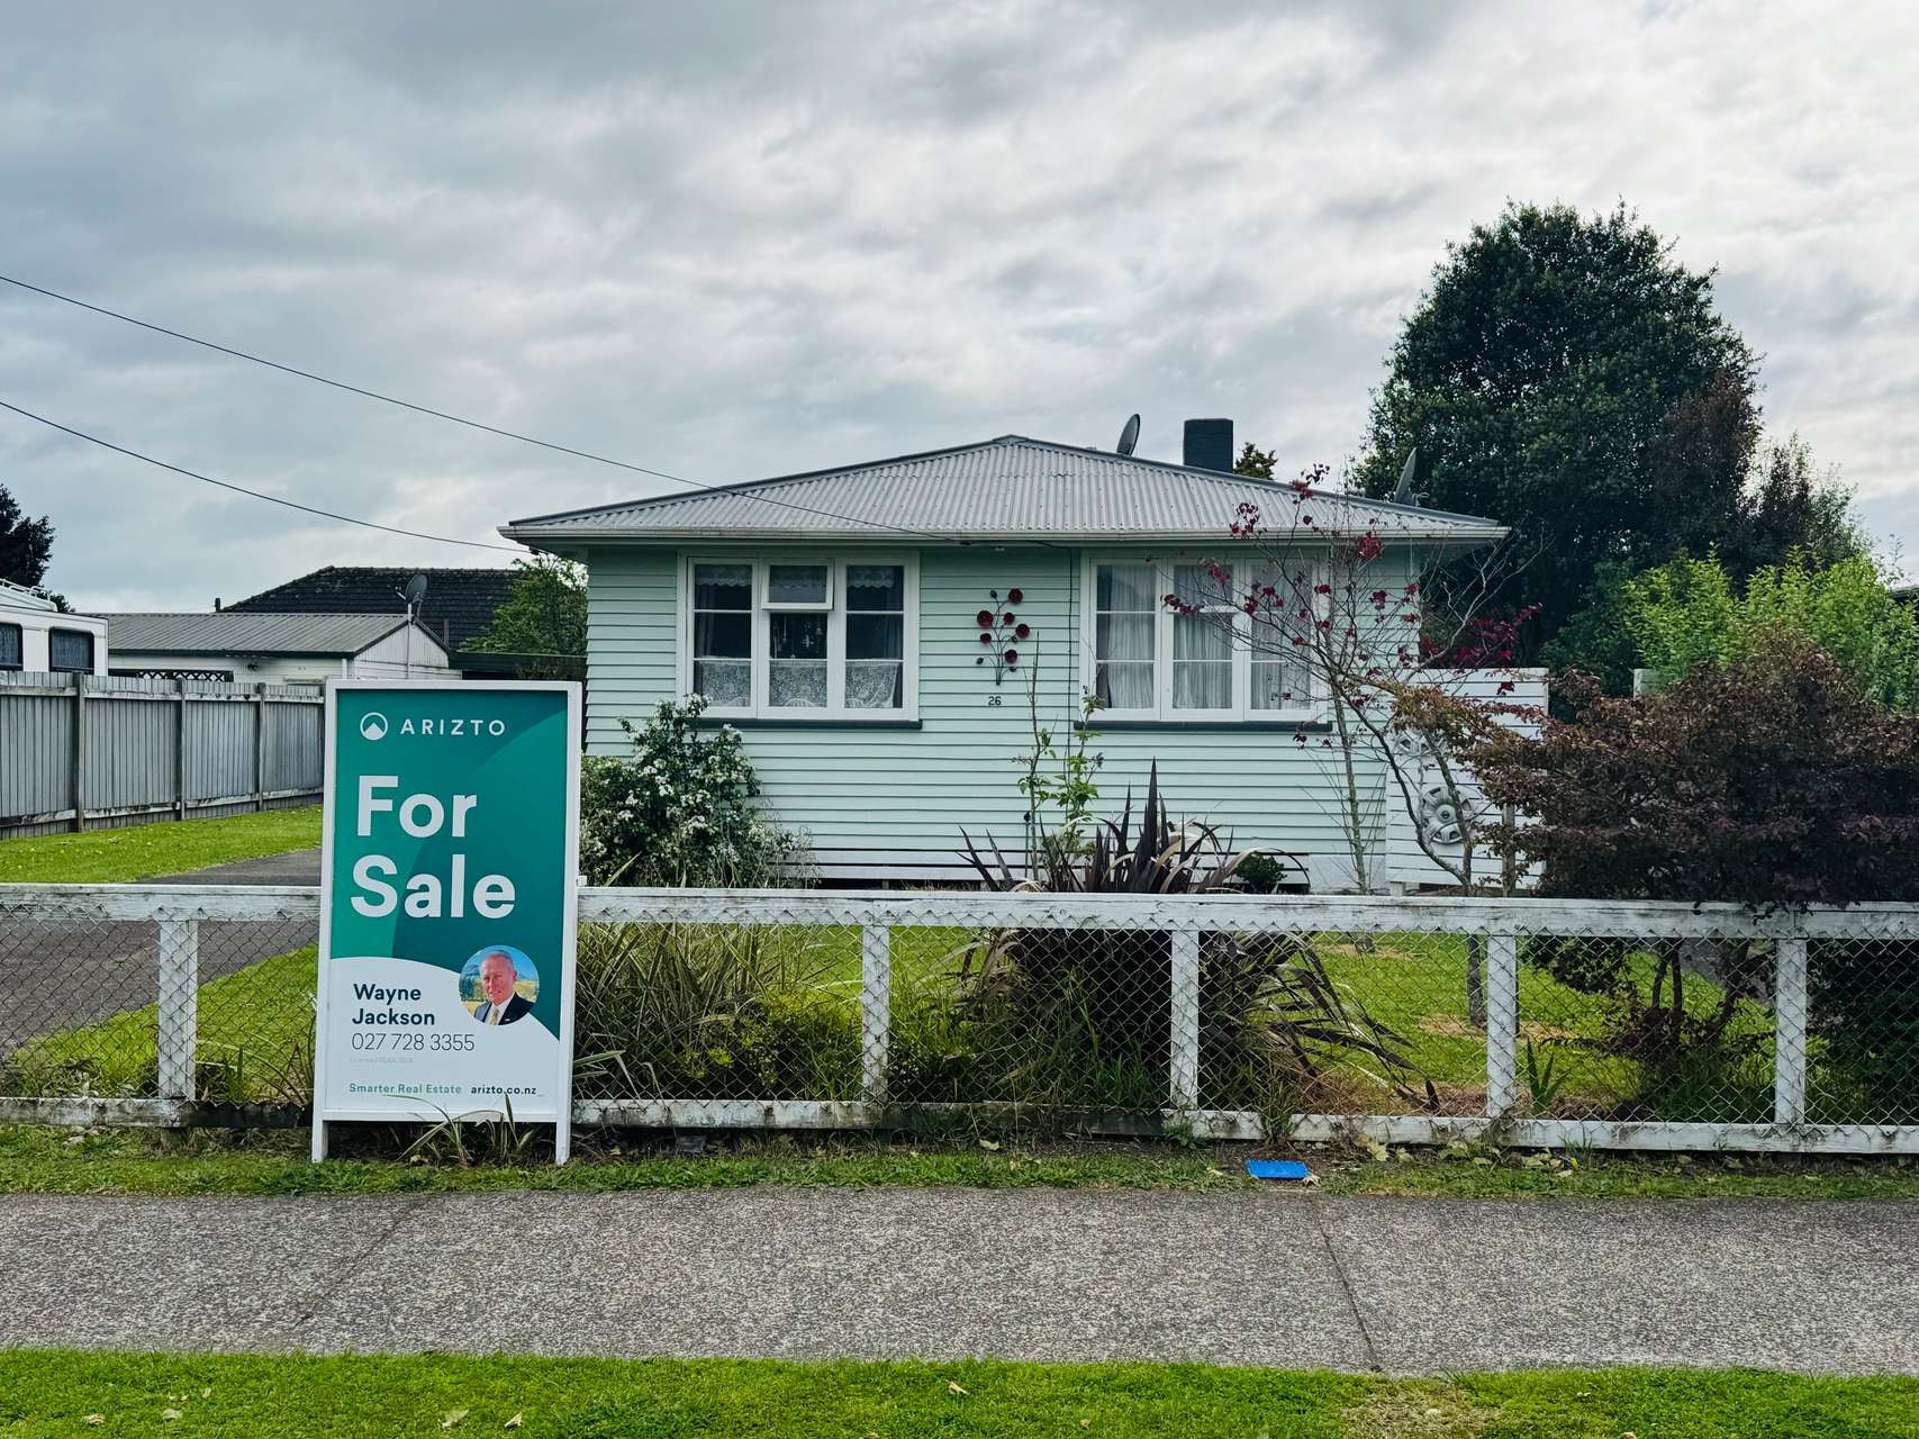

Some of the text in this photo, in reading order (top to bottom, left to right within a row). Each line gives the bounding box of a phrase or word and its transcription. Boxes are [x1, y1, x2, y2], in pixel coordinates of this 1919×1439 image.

[988, 696, 1002, 706] 26
[400, 719, 506, 736] ARIZTO
[357, 775, 477, 838] For
[350, 854, 516, 919] Sale
[353, 983, 421, 1005] Wayne
[352, 1008, 435, 1026] Jackson
[352, 1032, 475, 1051] 027 728 3355
[349, 1083, 462, 1095] Smarter Real Estate
[471, 1085, 537, 1095] arizto.co.nz
